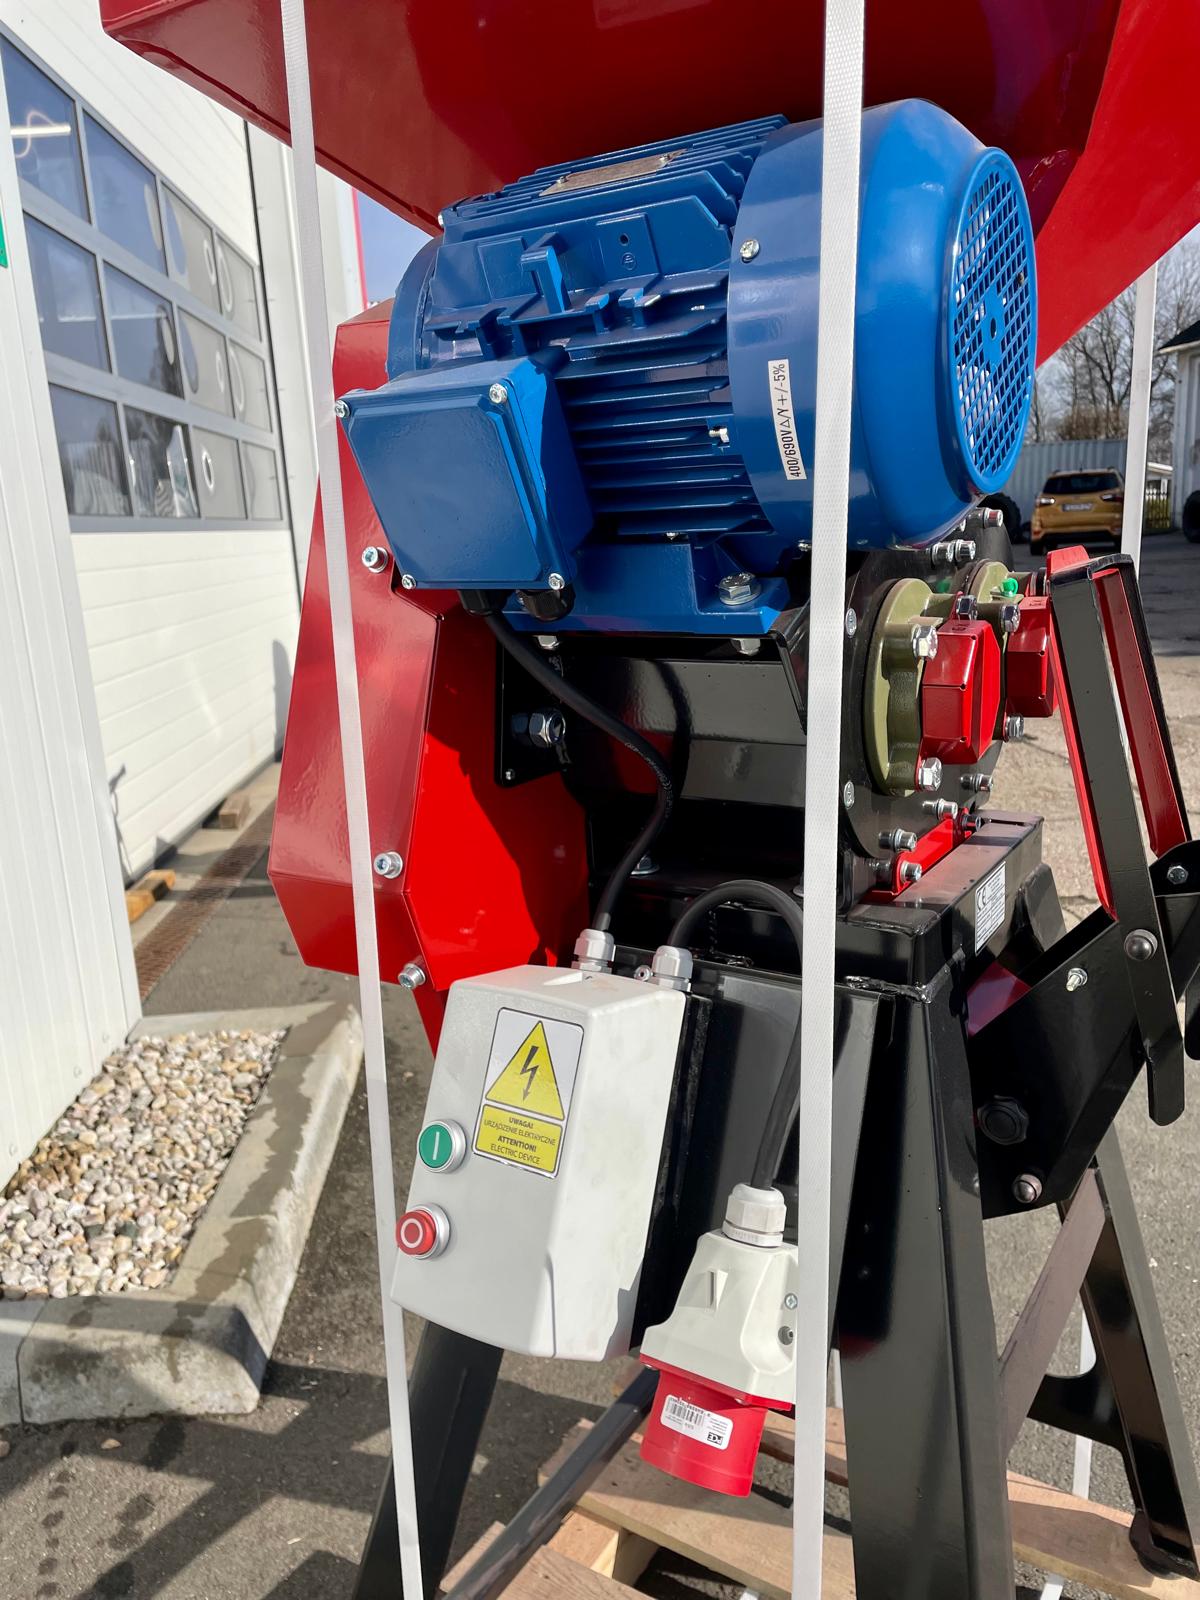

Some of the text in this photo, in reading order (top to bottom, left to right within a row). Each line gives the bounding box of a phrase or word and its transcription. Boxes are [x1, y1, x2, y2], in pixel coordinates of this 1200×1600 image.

[509, 1117, 533, 1129] UWAGA!
[484, 1120, 556, 1146] URZĄDZENIE ELEKTRYCZNE
[498, 1136, 537, 1152] ATTENTION!
[491, 1143, 541, 1165] ELECTRIC DEVICE
